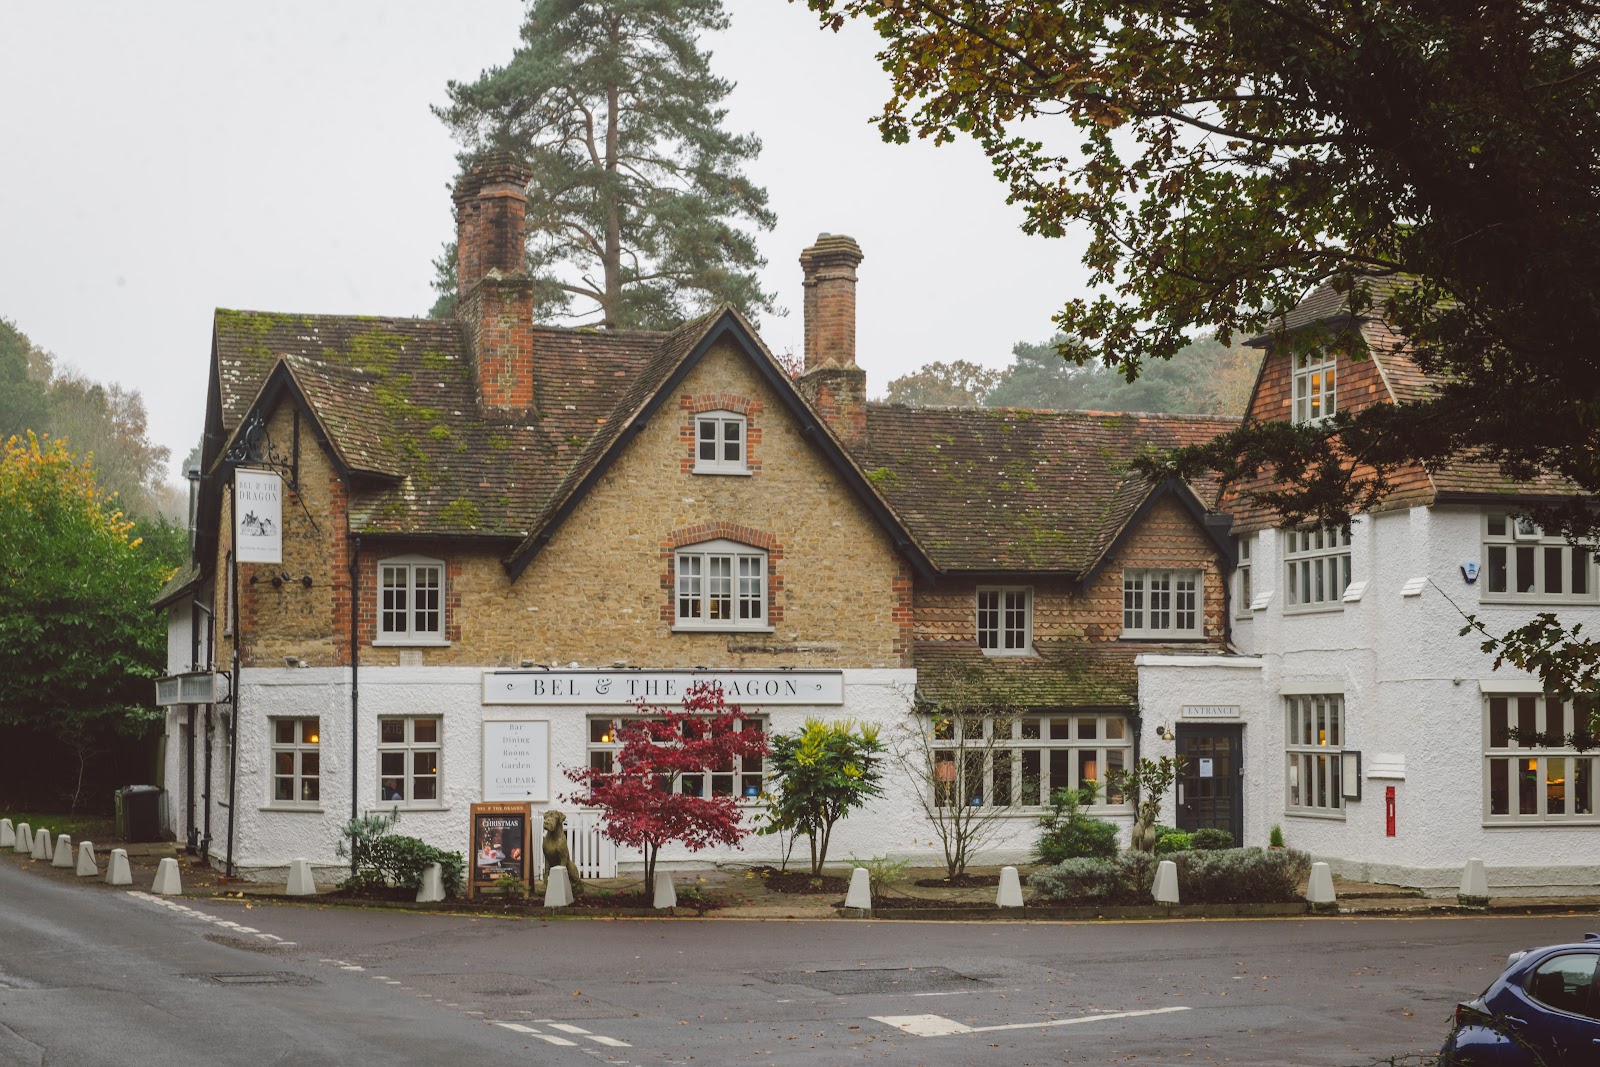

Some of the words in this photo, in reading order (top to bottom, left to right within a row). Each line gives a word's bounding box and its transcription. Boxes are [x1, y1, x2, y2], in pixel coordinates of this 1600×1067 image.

[239, 481, 252, 489] BEL
[264, 483, 278, 491] THE
[239, 491, 277, 501] DRAGON
[533, 679, 580, 696] BEL
[595, 678, 612, 695] &
[626, 679, 676, 696] THE
